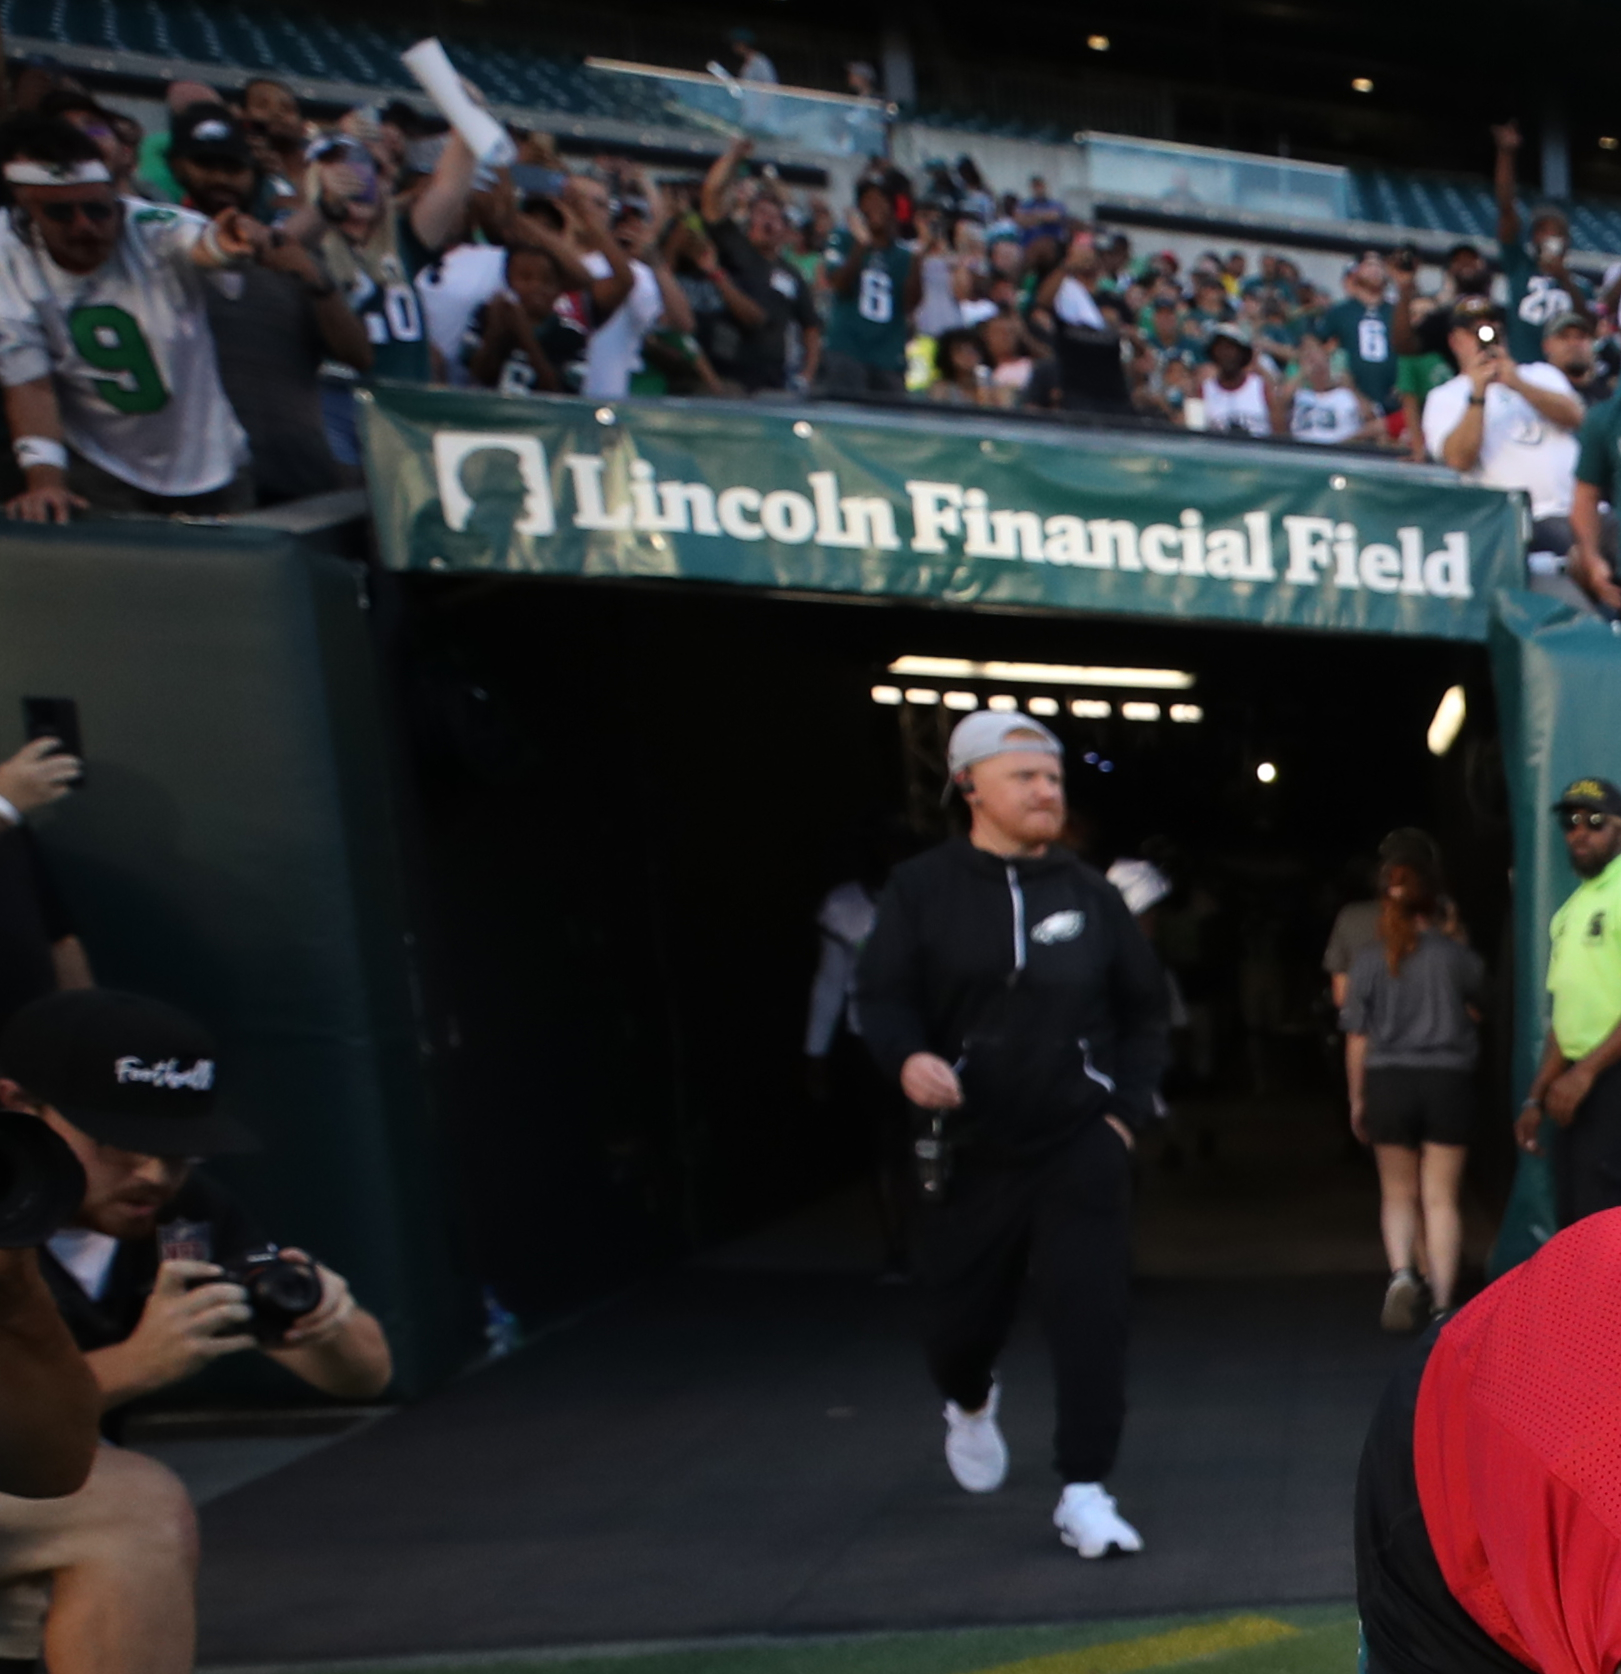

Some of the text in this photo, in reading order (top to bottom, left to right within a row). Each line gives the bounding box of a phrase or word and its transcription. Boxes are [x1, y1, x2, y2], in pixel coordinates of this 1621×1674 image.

[860, 269, 893, 323] 6
[70, 304, 170, 415] 9
[1358, 319, 1388, 363] 6
[565, 453, 1473, 599] Lincoln Financial Field
[115, 1056, 215, 1090] Football
